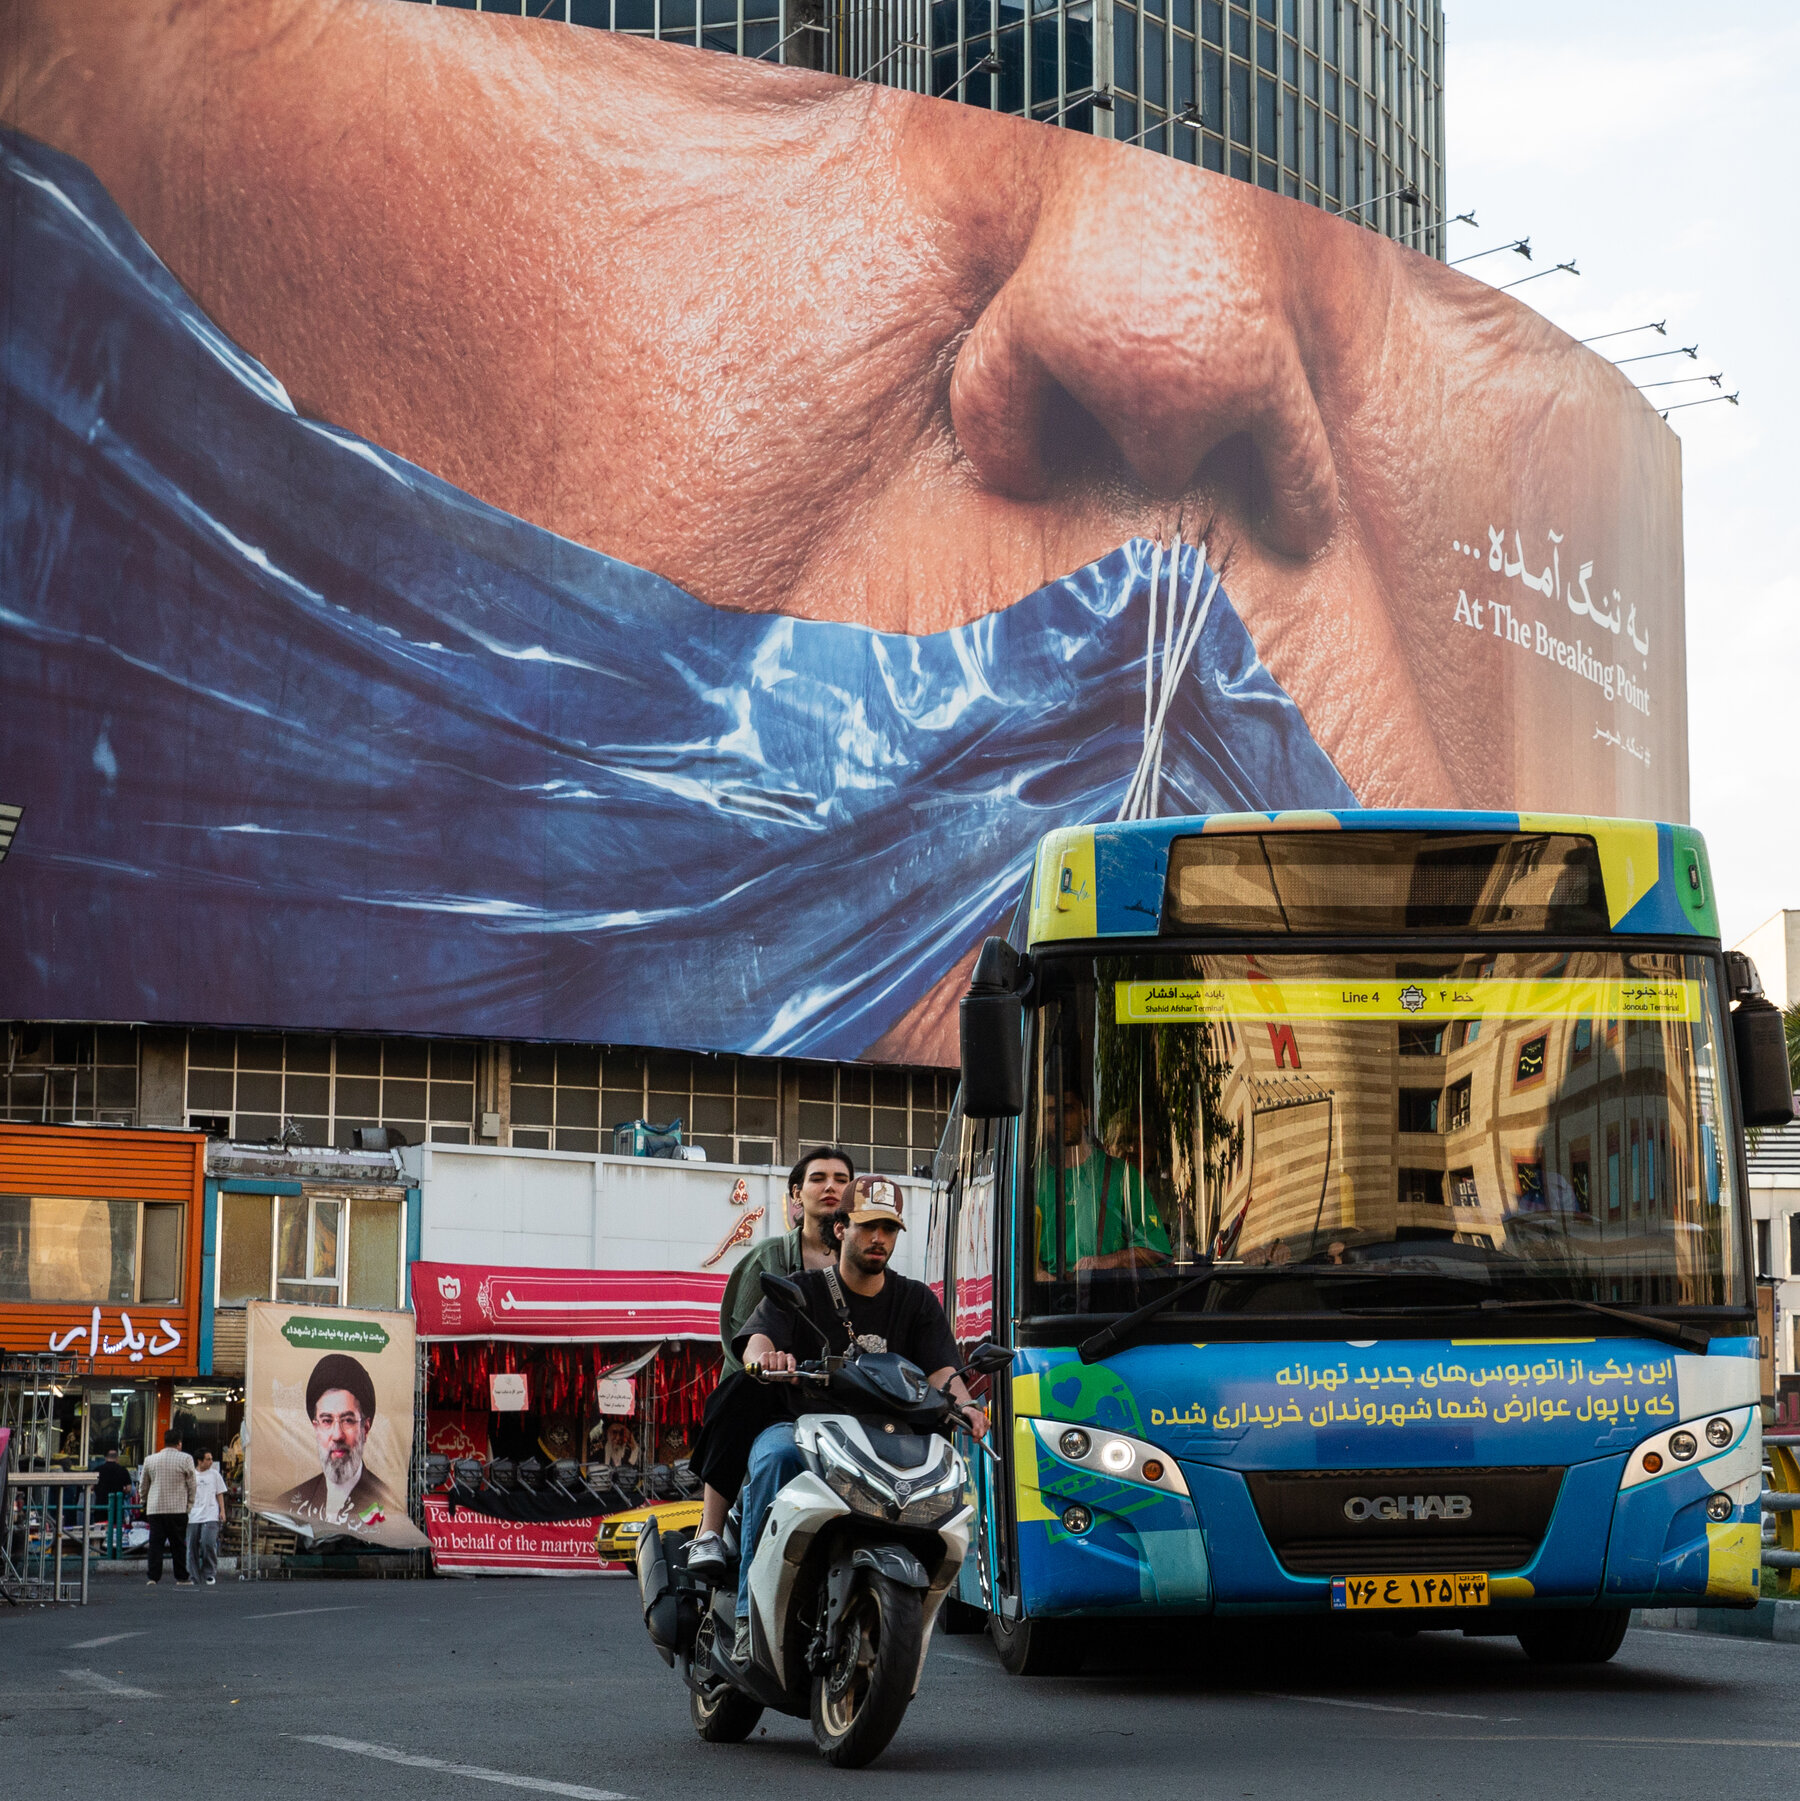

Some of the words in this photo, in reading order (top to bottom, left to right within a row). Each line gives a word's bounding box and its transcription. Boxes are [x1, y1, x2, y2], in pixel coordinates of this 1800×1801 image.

[1567, 560, 1621, 635] تنگ
[1626, 602, 1650, 671] به
[1453, 589, 1485, 631] At
[1488, 600, 1532, 649] The
[1534, 620, 1615, 701] Breaking
[1616, 664, 1651, 717] Point
[1145, 987, 1178, 1001] افشار
[1179, 990, 1202, 1000] شهید
[1204, 990, 1225, 1000] پایانه
[1342, 992, 1368, 1003] Line
[1371, 992, 1380, 1003] 4
[1440, 991, 1448, 1003] ۴
[1452, 991, 1474, 1003] خط
[1621, 986, 1657, 1000] جنوب
[1658, 988, 1678, 999] پایانه
[1145, 1005, 1169, 1013] Shahid
[1171, 1004, 1192, 1012] Afshar
[1193, 1004, 1224, 1012] Terminal
[1622, 1003, 1648, 1011] Jonoub
[1650, 1003, 1680, 1011] Terminal
[49, 1306, 181, 1362] دیدار
[311, 1327, 318, 1339] از
[318, 1328, 337, 1340] نیابت
[337, 1330, 344, 1341] به
[362, 1331, 369, 1342] با
[1275, 1362, 1349, 1392] تهرانه
[1353, 1364, 1415, 1390] جدید
[1567, 1359, 1583, 1385] از
[1588, 1358, 1633, 1386] یکی
[1638, 1358, 1673, 1385] این
[1151, 1402, 1207, 1426] شده
[1212, 1398, 1304, 1429] خریداری
[1309, 1397, 1432, 1427] شهروندان
[1436, 1396, 1488, 1420] شما
[1493, 1393, 1571, 1424] عوارض
[1576, 1395, 1619, 1426] پول
[1623, 1395, 1640, 1423] با
[1644, 1393, 1675, 1415] که
[1343, 1495, 1473, 1521] OGHAB
[451, 1532, 495, 1549] behalf
[498, 1534, 513, 1550] of
[515, 1534, 537, 1551] the
[541, 1538, 596, 1557] martyrs
[1458, 1581, 1486, 1604] ۳۳
